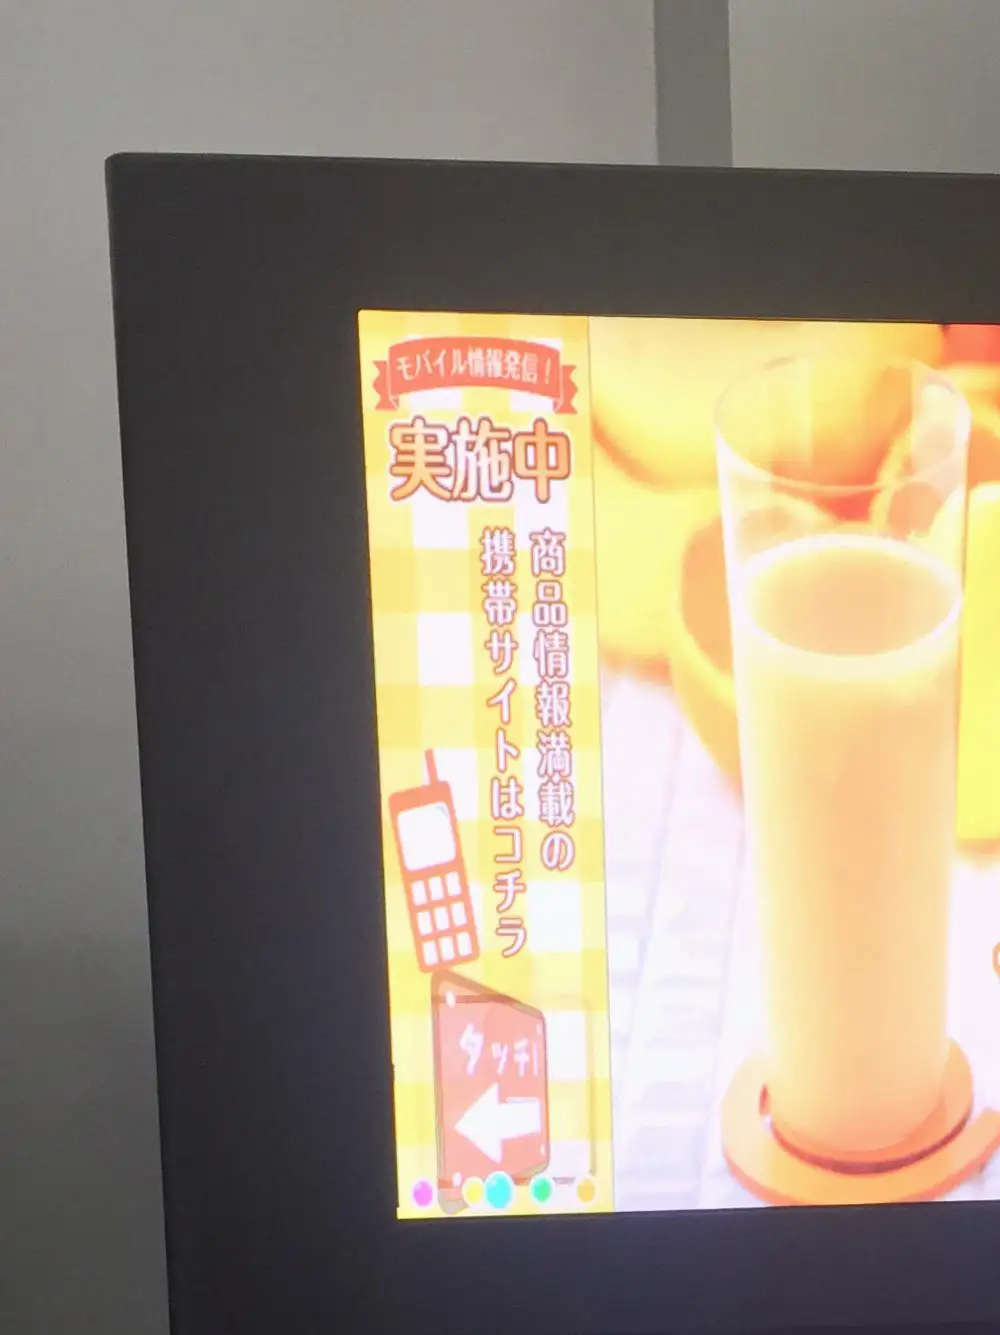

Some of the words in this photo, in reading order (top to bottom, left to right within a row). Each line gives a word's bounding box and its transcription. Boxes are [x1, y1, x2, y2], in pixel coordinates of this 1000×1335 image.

[389, 415, 571, 504] 実施中
[396, 346, 553, 385] モバイル情報発信！
[479, 526, 528, 958] 携帯サイトはコチラ
[529, 527, 576, 871] 商品情報満載の
